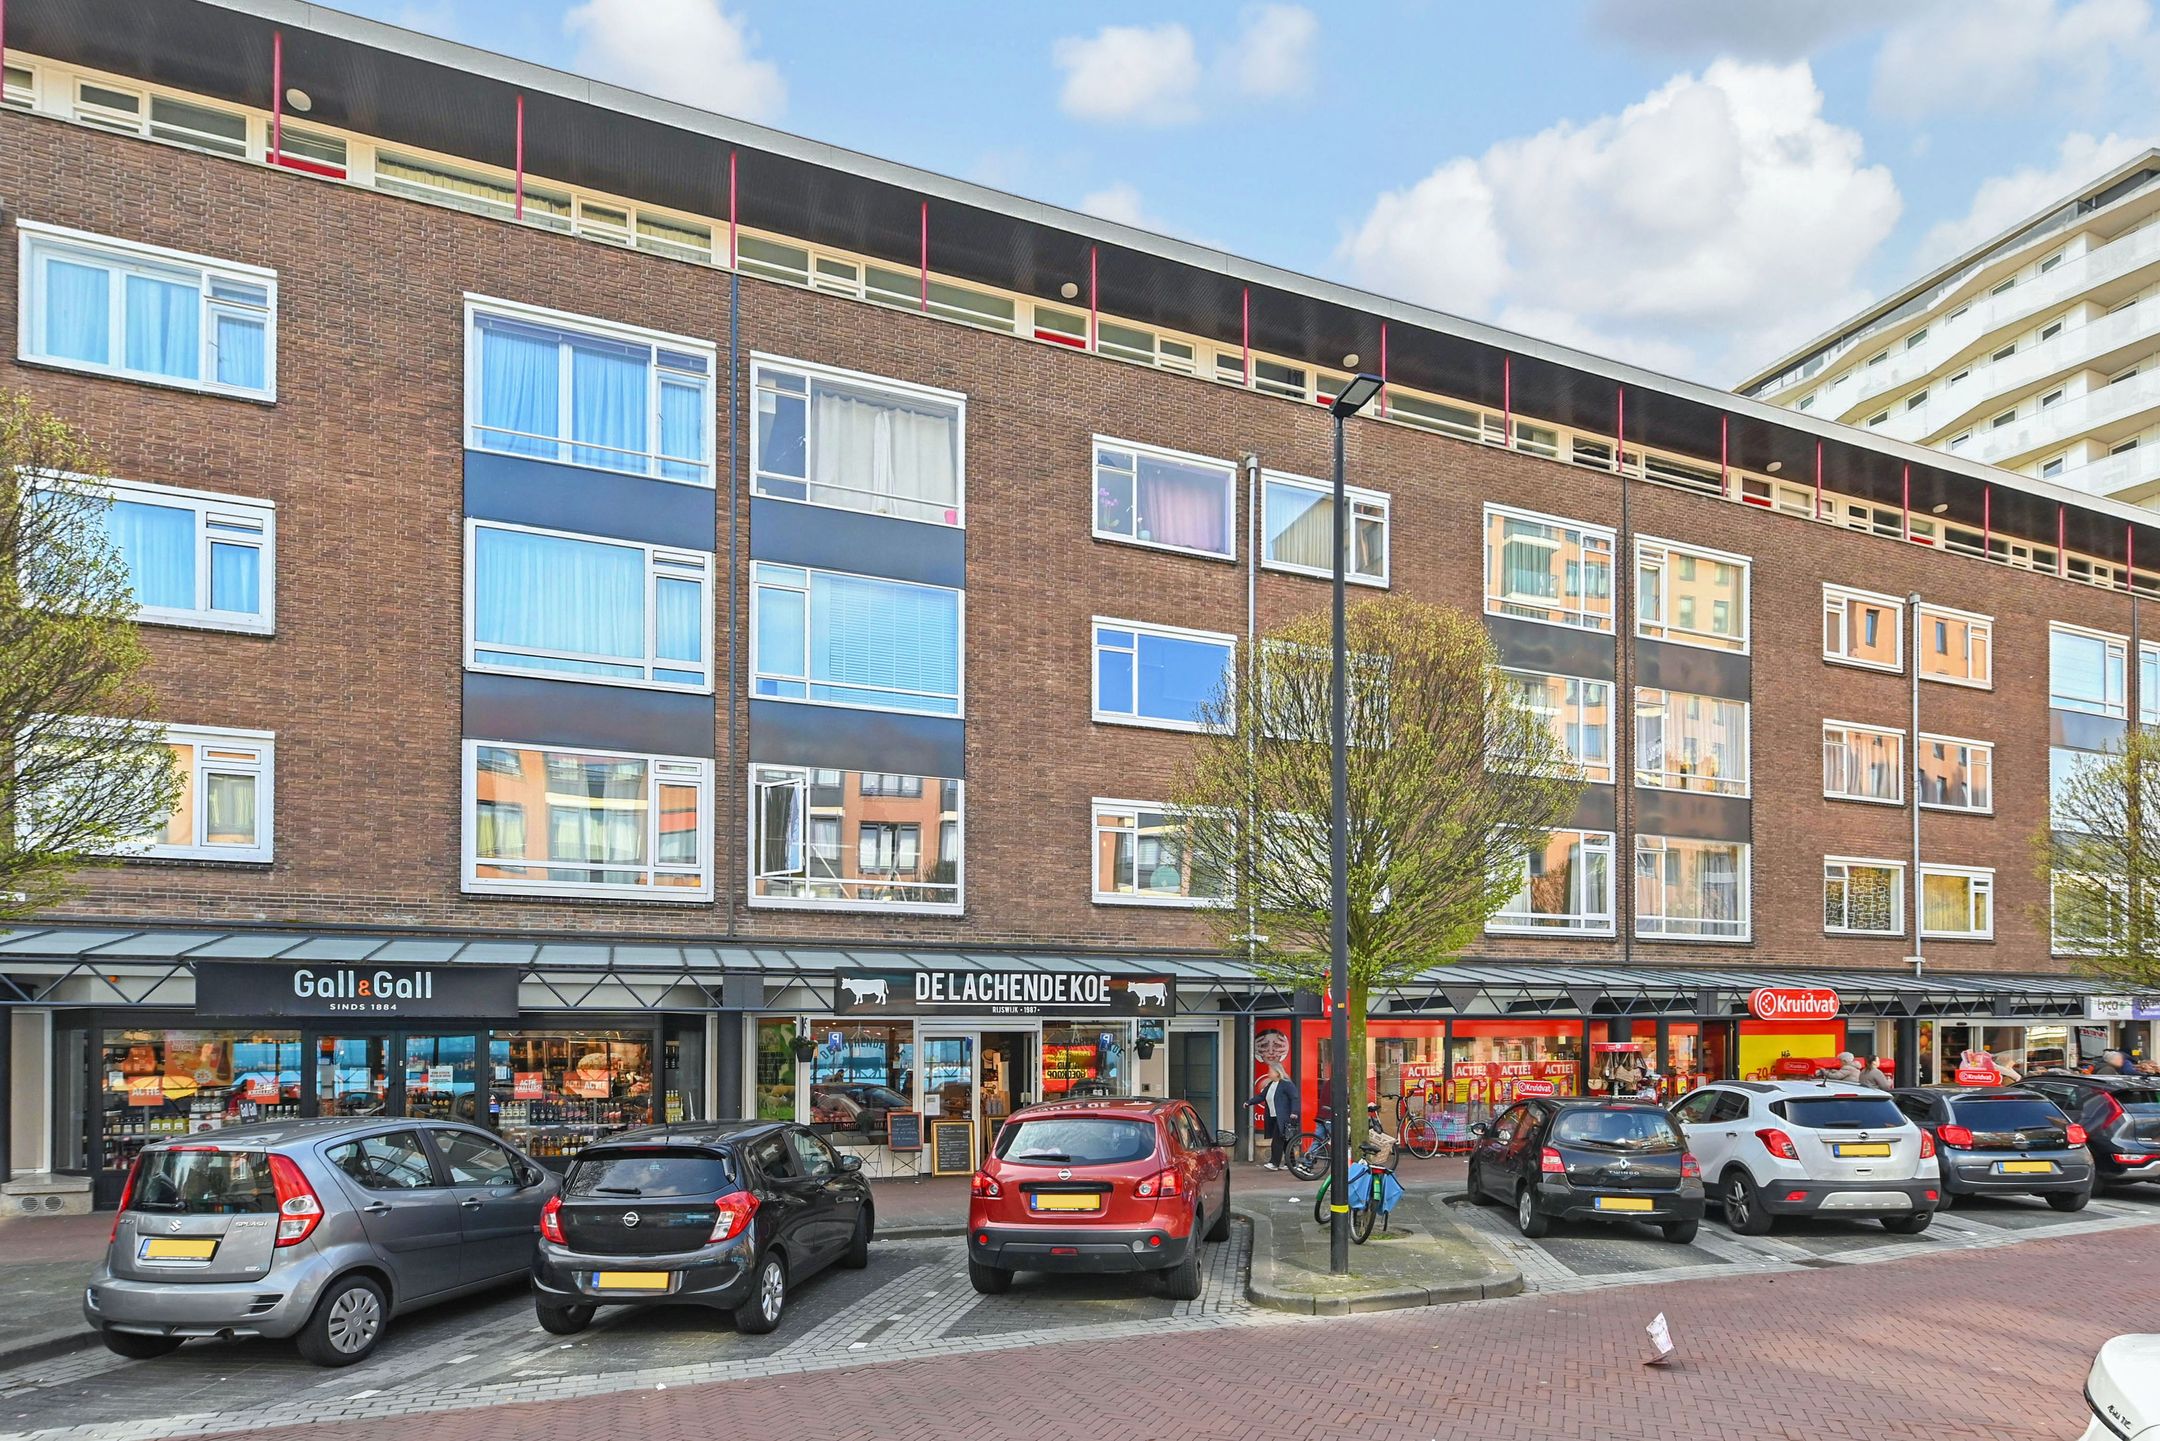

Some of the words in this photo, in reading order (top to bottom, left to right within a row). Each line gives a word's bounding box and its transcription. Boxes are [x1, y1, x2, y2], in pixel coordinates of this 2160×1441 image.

[915, 972, 945, 1000] DE
[949, 973, 1067, 1001] LACHENDE
[1070, 975, 1111, 1002] KOE
[330, 1003, 366, 1011] SINDS
[1777, 993, 1835, 1013] Kruidvat
[2097, 999, 2118, 1012] Lyca
[992, 1006, 1019, 1014] RIJSWIJK
[1023, 1006, 1037, 1014] 1987
[1501, 1065, 1531, 1076] ACTIE!
[1545, 1064, 1573, 1074] ACTIE!
[1525, 1082, 1551, 1093] Kruidvat
